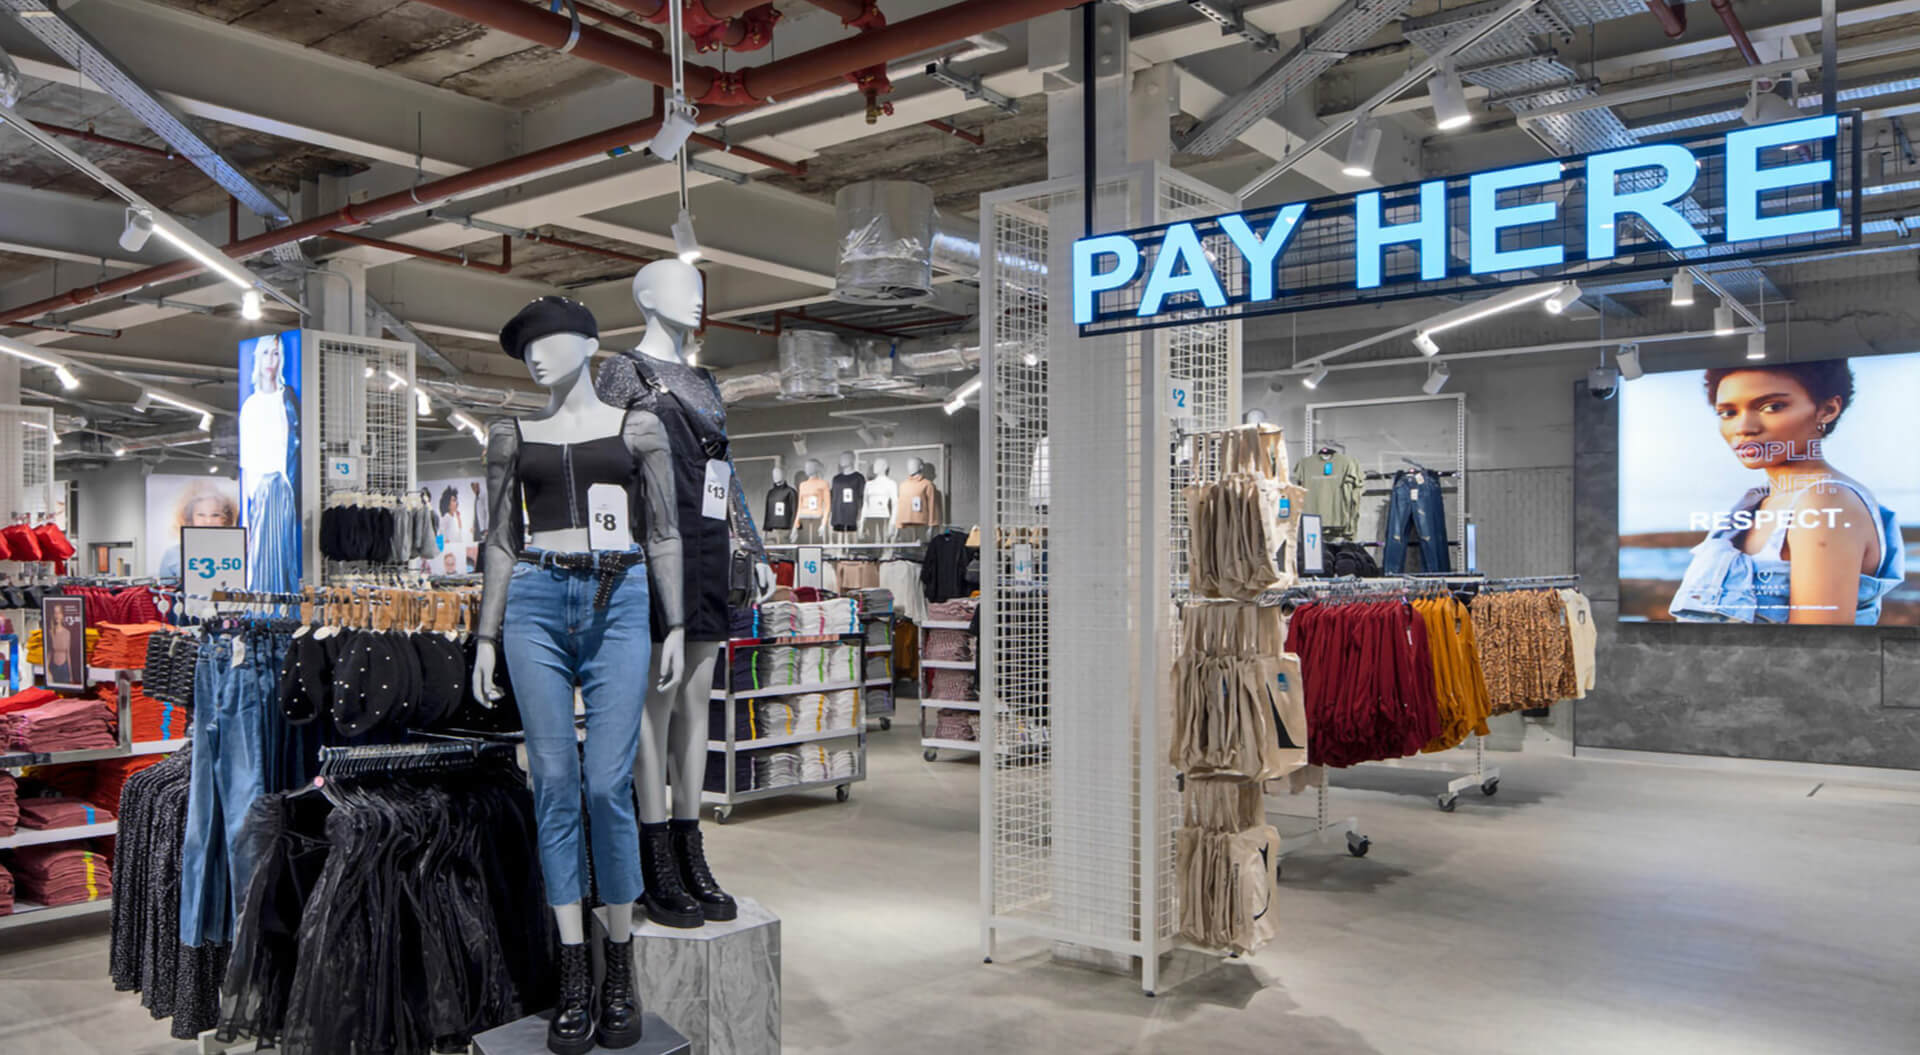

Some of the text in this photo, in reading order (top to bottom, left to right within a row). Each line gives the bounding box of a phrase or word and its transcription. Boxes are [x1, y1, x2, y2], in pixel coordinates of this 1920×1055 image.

[1073, 114, 1842, 325] PAY HERE
[1172, 388, 1185, 408] £2
[708, 484, 726, 500] £13
[595, 512, 617, 532] £8
[1689, 507, 1852, 532] RESPECT.
[188, 557, 242, 580] £3.50
[803, 560, 817, 575] £6
